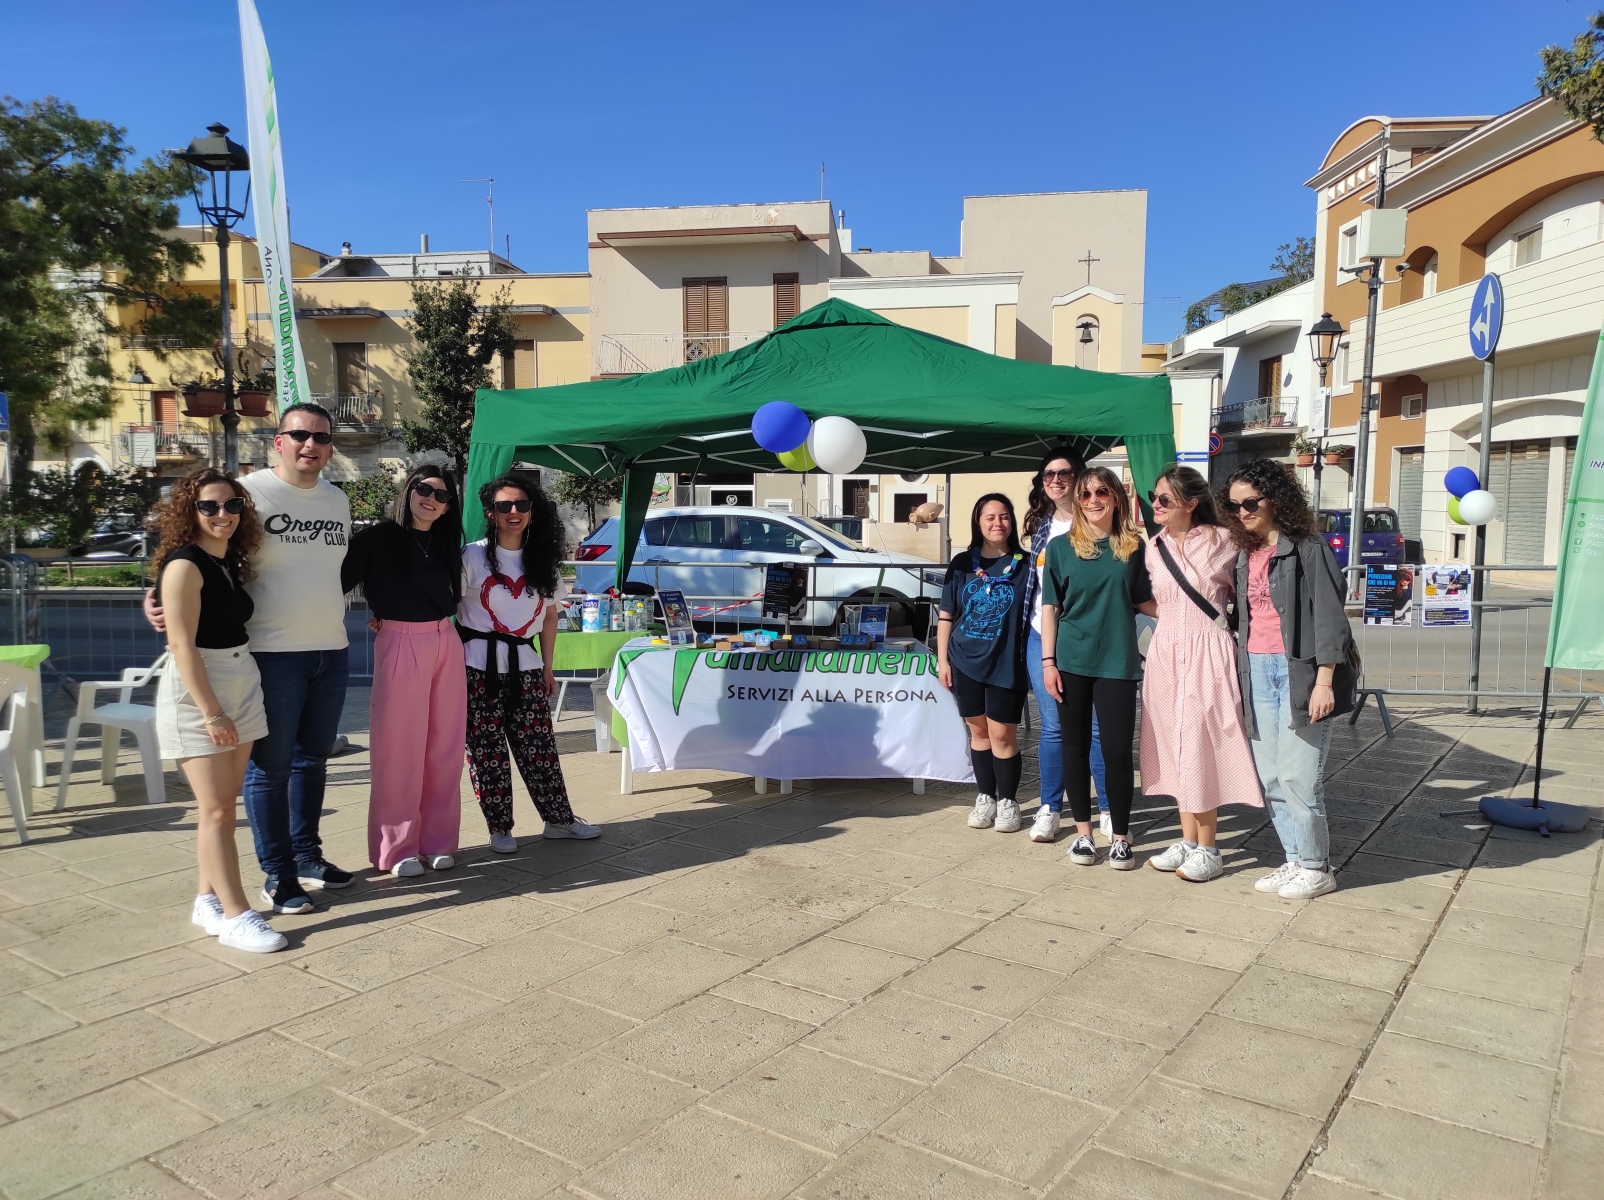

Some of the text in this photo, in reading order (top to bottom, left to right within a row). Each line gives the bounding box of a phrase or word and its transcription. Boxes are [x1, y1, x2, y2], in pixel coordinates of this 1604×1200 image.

[264, 513, 344, 540] Oregon
[279, 532, 346, 546] TRACK CLUB
[728, 684, 938, 704] SERVIZI ALLA PERSONA
